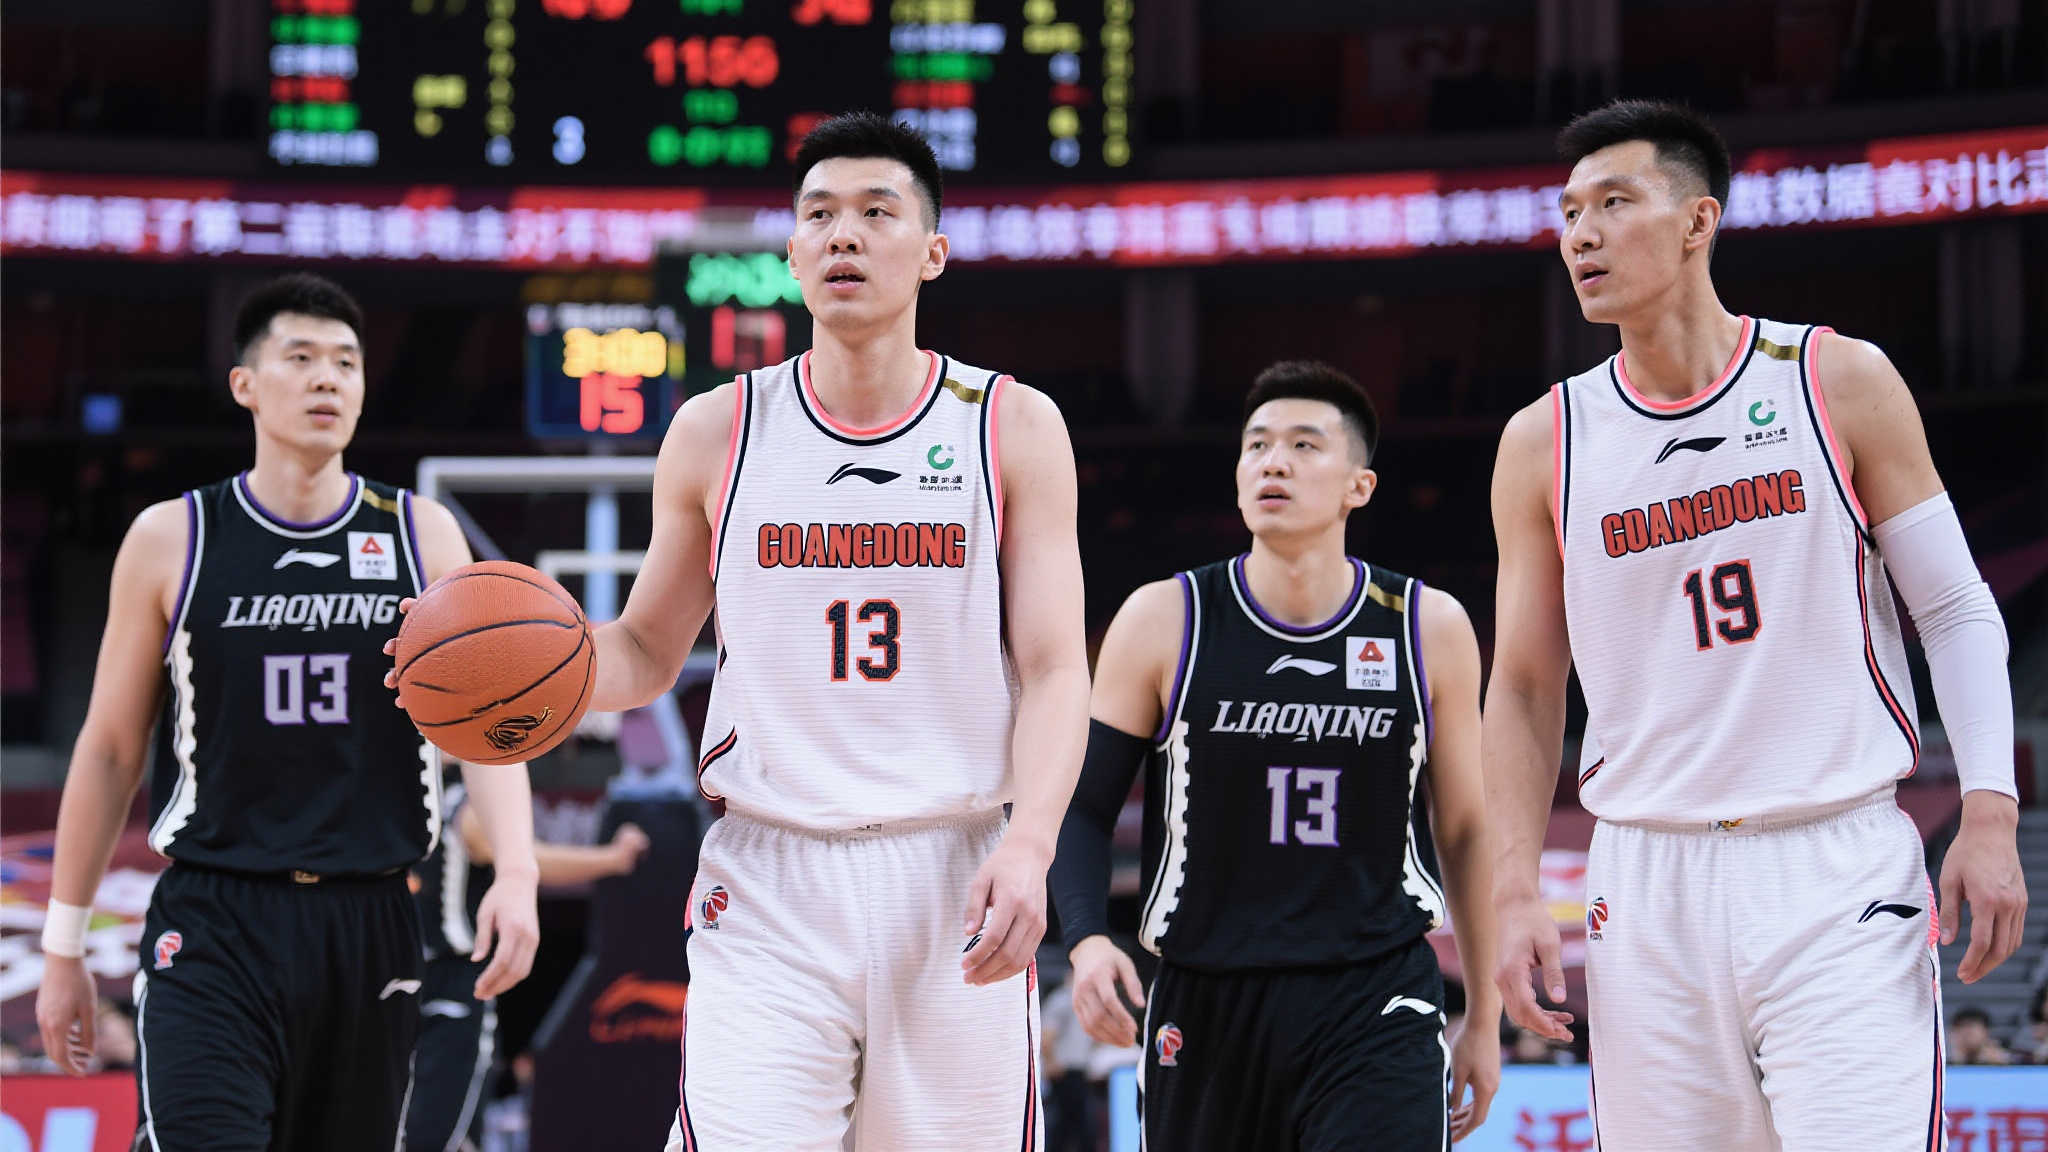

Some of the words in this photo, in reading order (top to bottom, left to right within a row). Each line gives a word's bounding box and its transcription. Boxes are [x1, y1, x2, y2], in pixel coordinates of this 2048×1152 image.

[580, 373, 644, 433] 15
[220, 593, 400, 631] LIAONING
[825, 598, 901, 682] 13
[1683, 558, 1763, 652] 19
[263, 653, 352, 725] 03
[1208, 700, 1398, 746] LIAONING
[1266, 766, 1343, 848] 13
